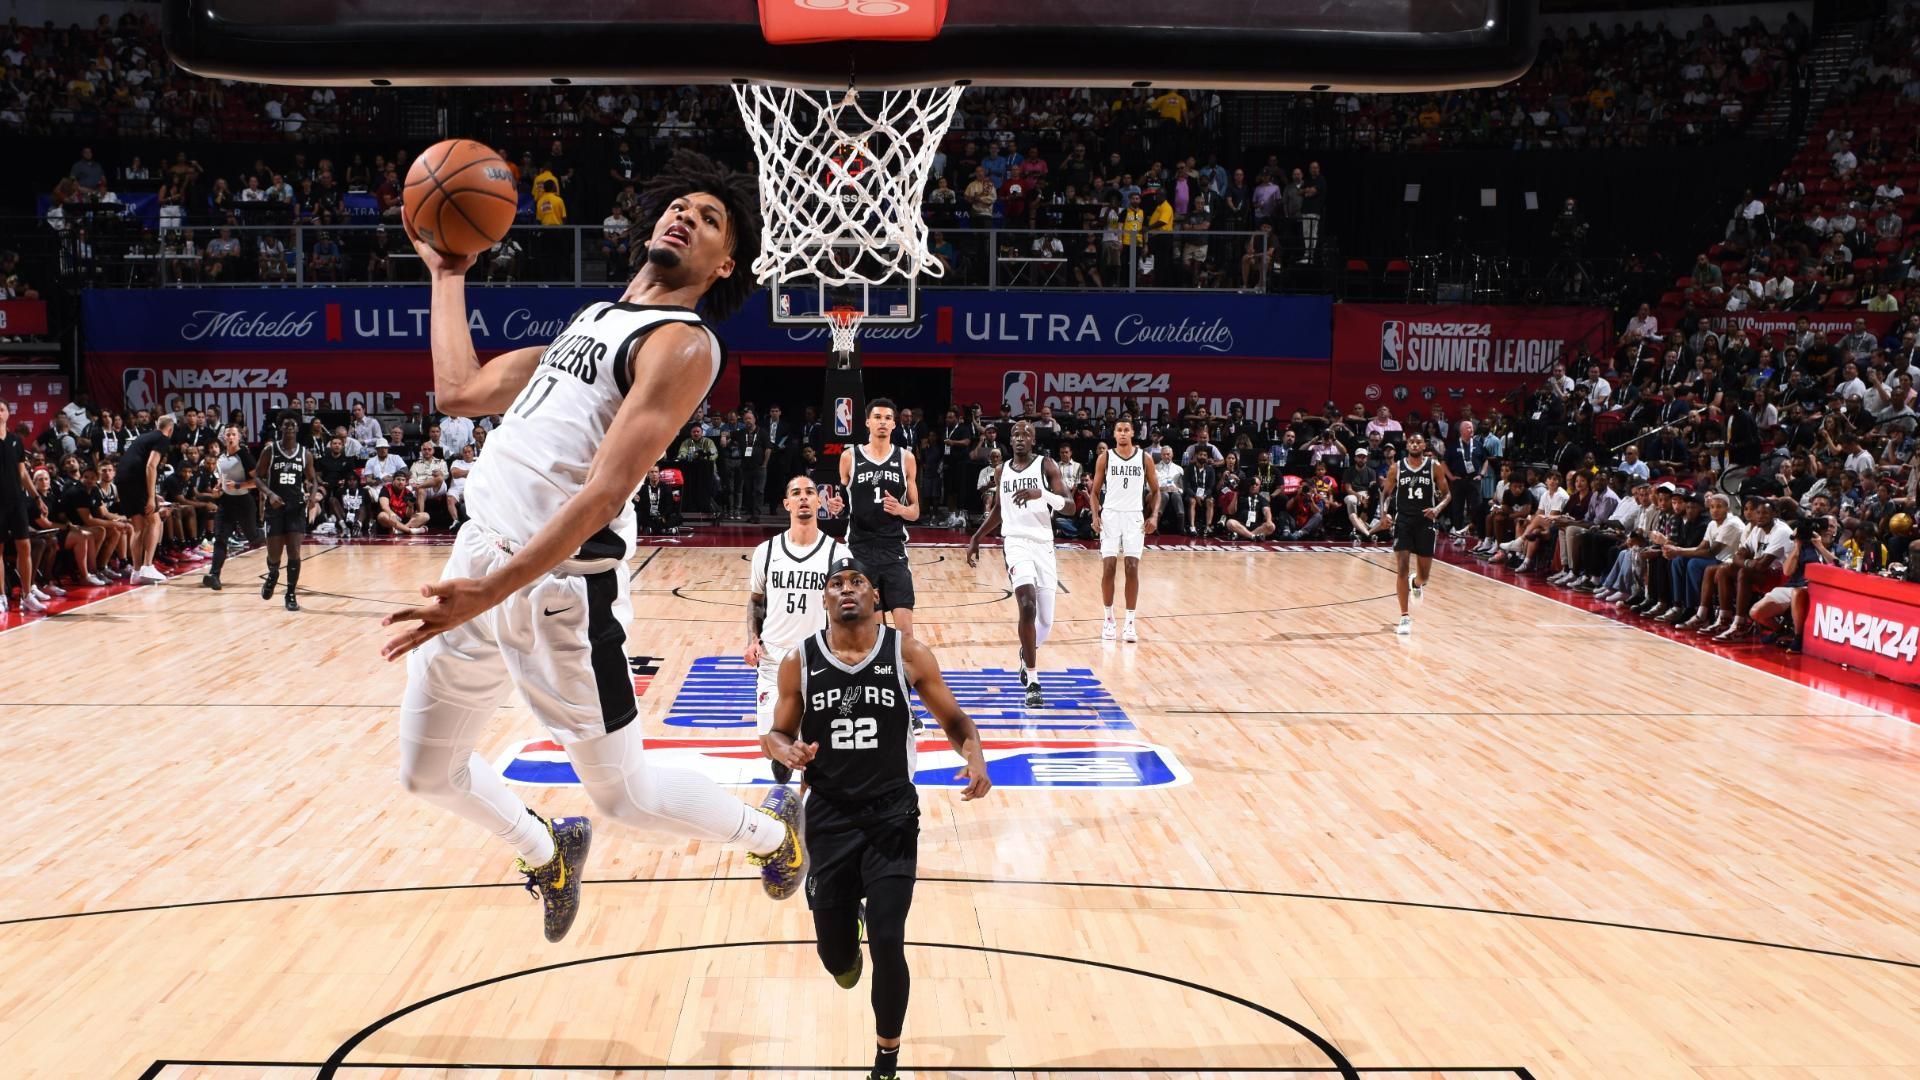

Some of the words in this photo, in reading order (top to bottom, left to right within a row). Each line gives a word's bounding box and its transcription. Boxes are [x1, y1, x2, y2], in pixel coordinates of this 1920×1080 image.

[181, 309, 318, 341] Michelob
[354, 309, 490, 337] ULTA
[966, 312, 1101, 342] ULTRA
[1114, 313, 1234, 352] Courtside
[1408, 322, 1492, 337] NBA2K24
[1406, 337, 1489, 373] SUMMER
[162, 368, 288, 389] NBA2K24
[1043, 372, 1171, 393] NBA2K24
[279, 472, 296, 485] 25
[1111, 464, 1142, 477] BLAZERS
[1122, 477, 1129, 490] 8
[1407, 487, 1424, 499] 14
[873, 486, 882, 504] 1
[771, 570, 826, 591] BLAZERS
[786, 592, 807, 614] 54
[1813, 602, 1920, 662] NBA2K24
[873, 665, 894, 675] Self.
[830, 717, 878, 750] 22
